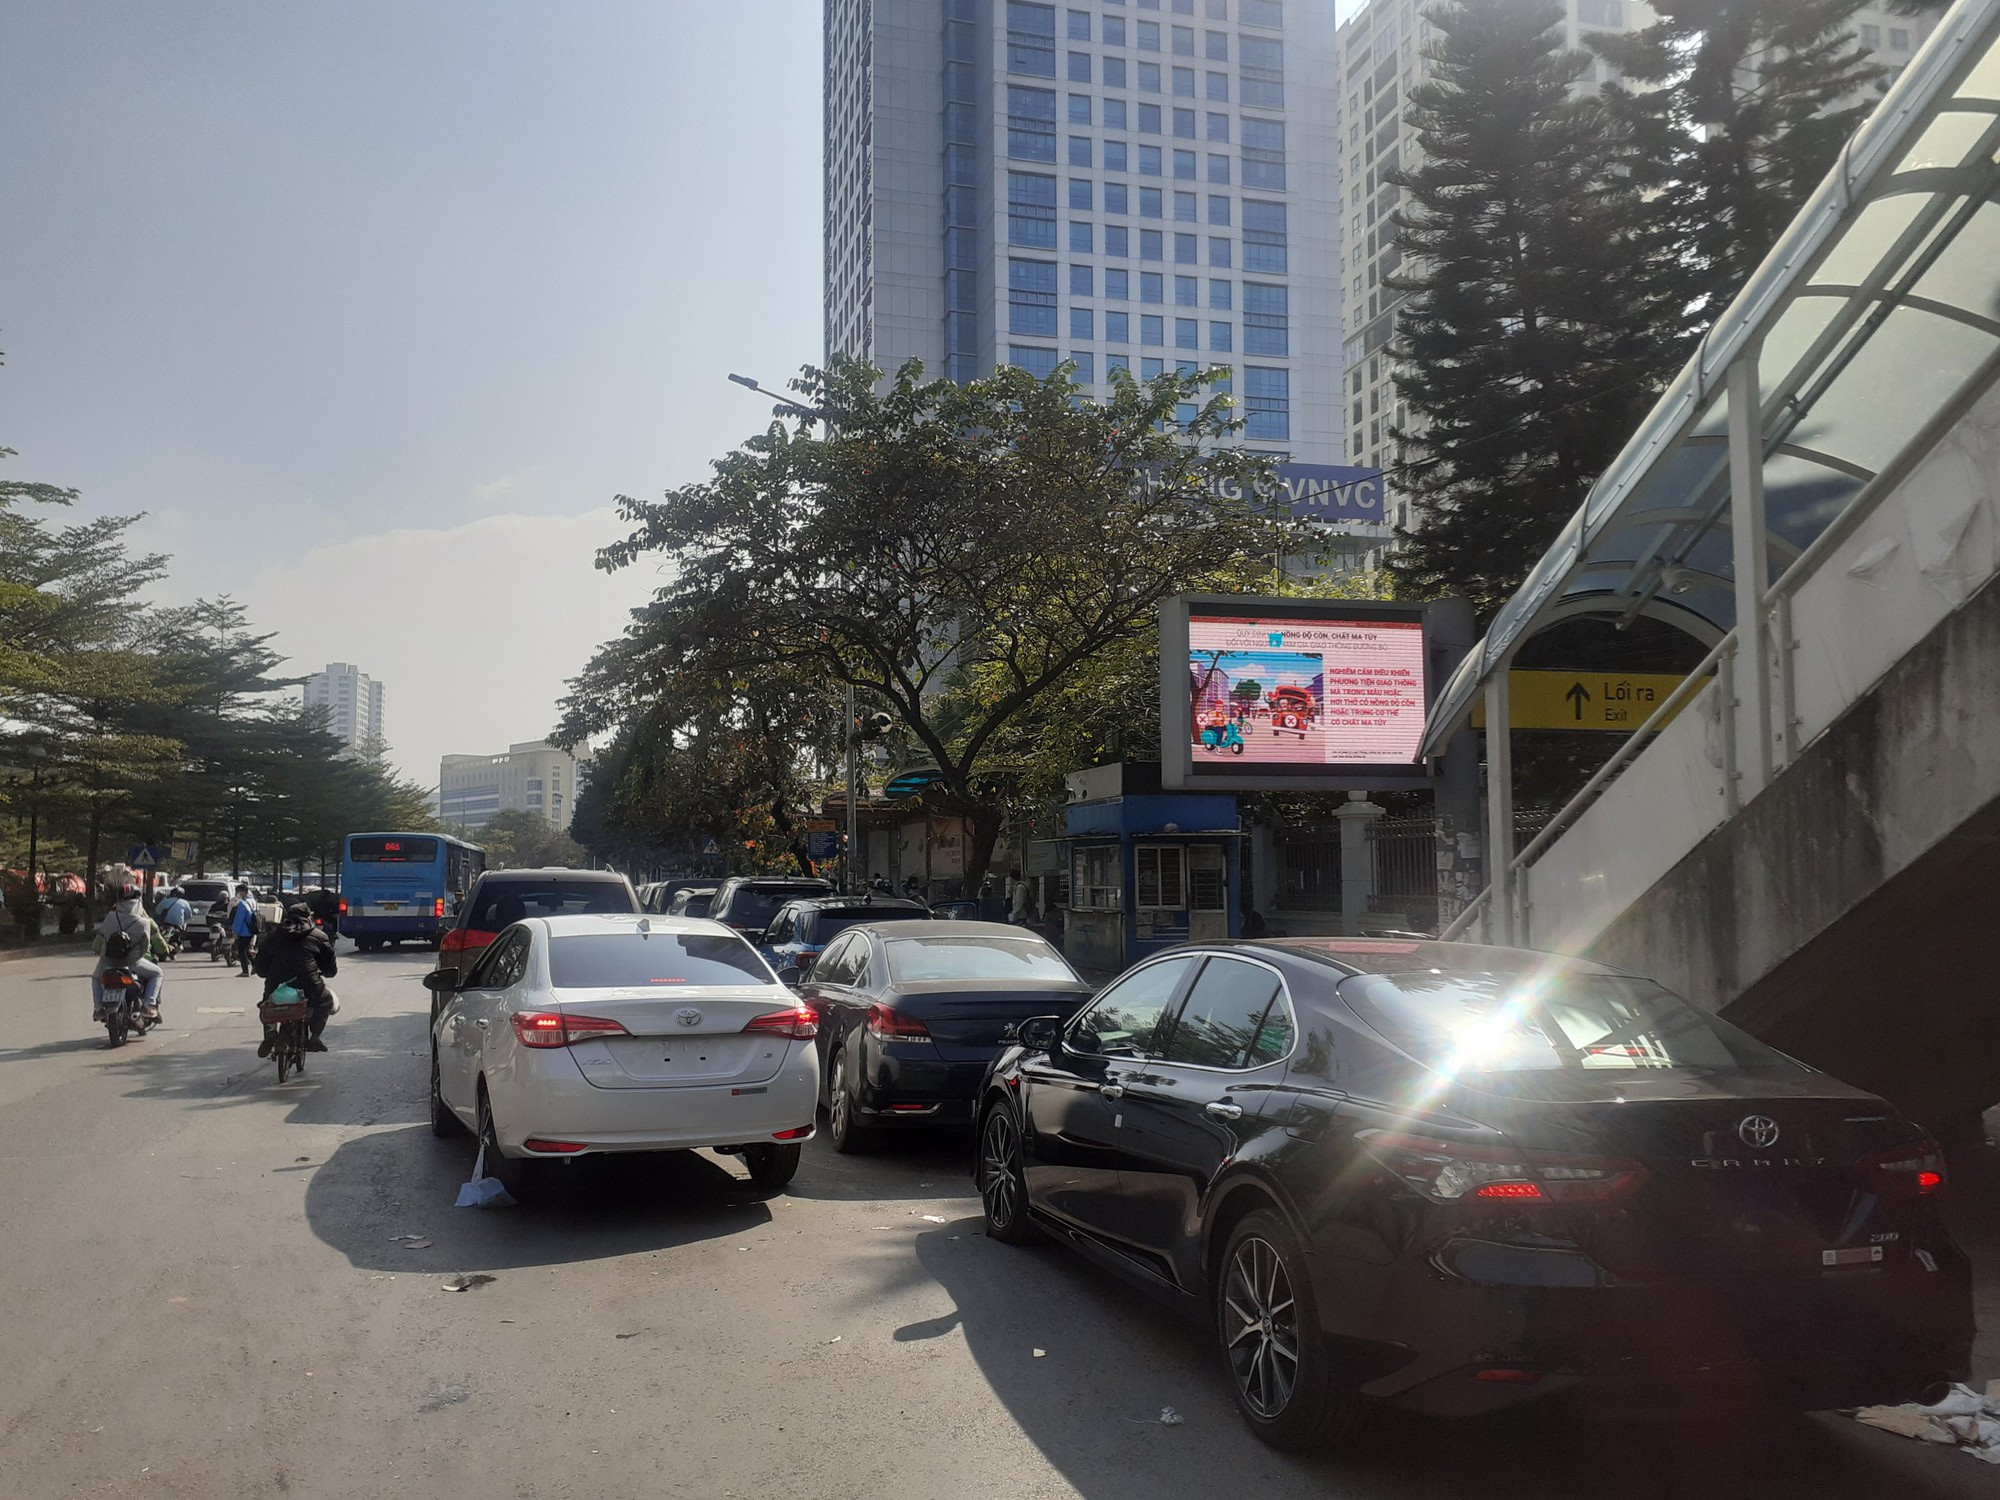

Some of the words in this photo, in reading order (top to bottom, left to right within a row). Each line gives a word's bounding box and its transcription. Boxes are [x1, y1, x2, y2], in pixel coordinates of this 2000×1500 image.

[1283, 476, 1377, 509] VNVC
[1352, 633, 1363, 641] MA
[1329, 667, 1356, 675] NGHIÊM
[1376, 679, 1392, 687] GIAO
[1394, 679, 1417, 687] THÔNG
[1604, 680, 1631, 701] Lối
[1637, 688, 1654, 701] ra
[1359, 697, 1369, 706] CÓ
[1605, 708, 1628, 721] Exit
[1331, 718, 1341, 726] CÓ
